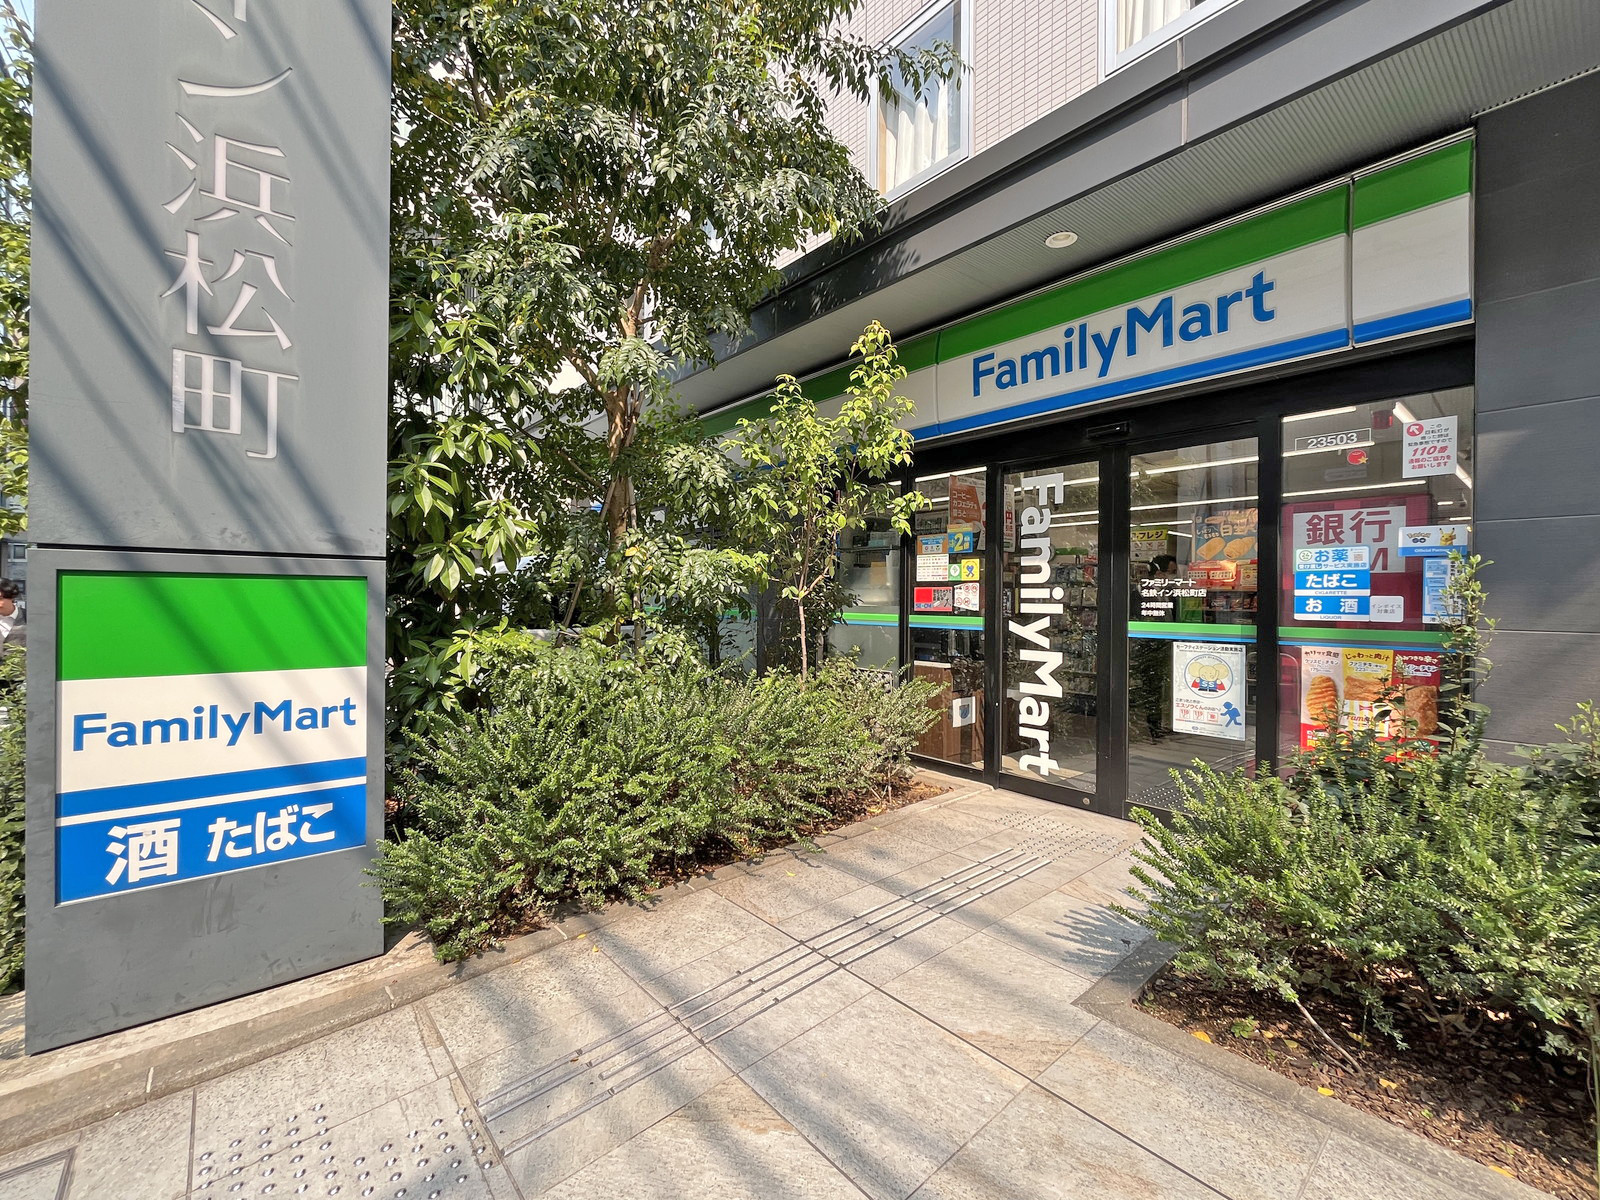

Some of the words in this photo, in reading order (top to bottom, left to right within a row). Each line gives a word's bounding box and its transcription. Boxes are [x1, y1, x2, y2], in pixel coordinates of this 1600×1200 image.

[159, 0, 299, 459] ン浜松町
[973, 270, 1275, 397] FamilyMart
[1307, 432, 1358, 450] 23503
[1411, 445, 1449, 457] 110番
[1411, 461, 1449, 470] お願いします
[1305, 510, 1392, 546] 銀行
[1314, 549, 1349, 563] お薬
[1140, 578, 1197, 587] ファミリーマート
[1305, 573, 1358, 588] たばこ
[1140, 588, 1207, 598] 名鉄イン浜松町店
[1140, 601, 1174, 609] 24時間営業
[1008, 472, 1064, 776] FamilyMart
[1344, 652, 1390, 662] じゅわっと肉汁
[72, 696, 357, 752] FamilyMart
[105, 817, 181, 885] 酒
[206, 802, 336, 862] たばこ
